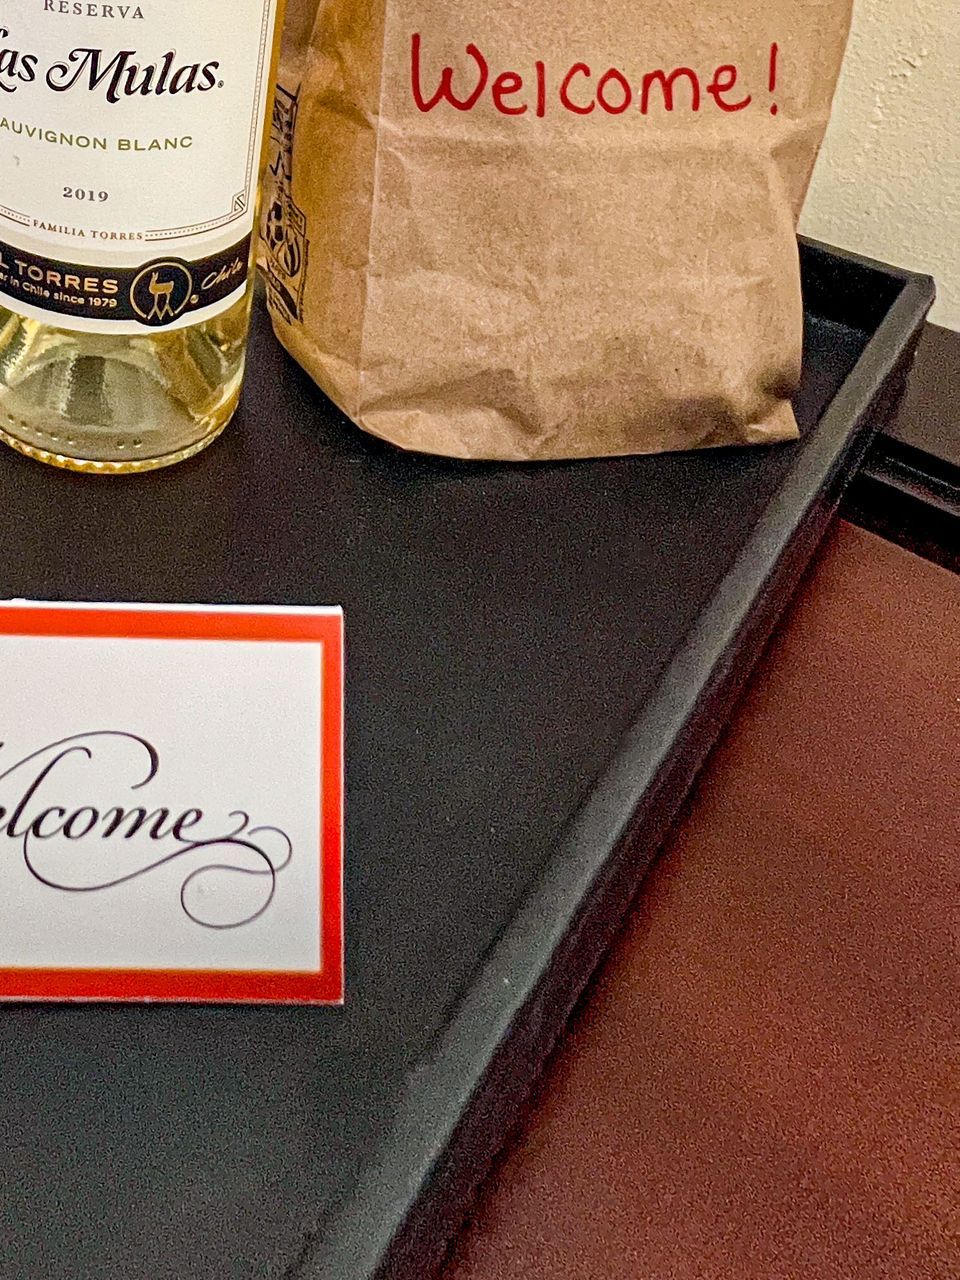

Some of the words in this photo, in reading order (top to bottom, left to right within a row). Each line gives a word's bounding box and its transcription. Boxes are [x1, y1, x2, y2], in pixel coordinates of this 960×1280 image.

[118, 135, 193, 151] BLANC
[63, 186, 109, 203] 2019
[33, 219, 86, 238] FAMILIA
[90, 230, 143, 241] TORRES
[14, 259, 119, 295] TORRES
[10, 274, 20, 287] in
[22, 281, 50, 299] Chile
[53, 291, 85, 305] since
[89, 297, 118, 308] 1979
